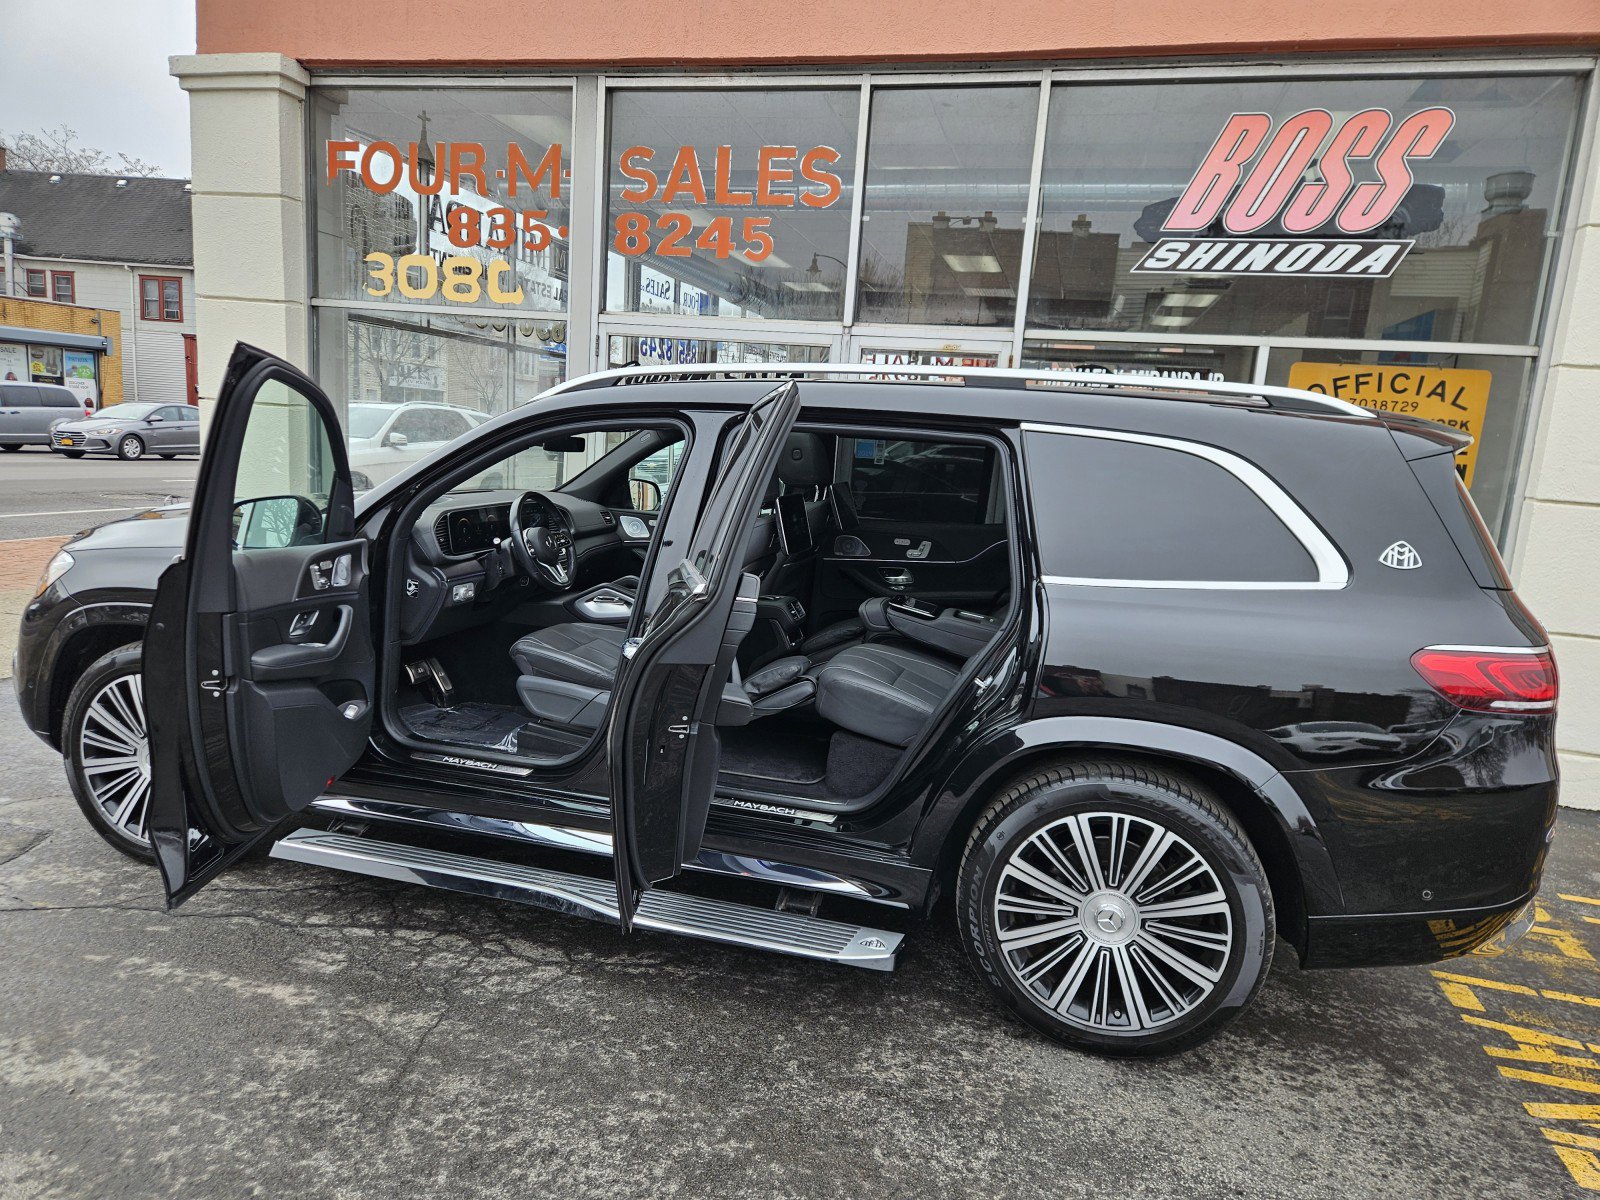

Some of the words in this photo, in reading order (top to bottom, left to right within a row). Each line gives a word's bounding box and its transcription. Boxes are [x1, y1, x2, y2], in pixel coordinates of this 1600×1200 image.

[619, 144, 842, 208] SALES
[1160, 106, 1456, 234] BOSS
[614, 212, 774, 262] 8245
[1144, 242, 1402, 273] SHINODA
[1349, 398, 1419, 412] 7038729
[443, 756, 498, 769] MAYBACH
[733, 800, 795, 815] MAYBACH
[968, 865, 1002, 988] SCORPION
